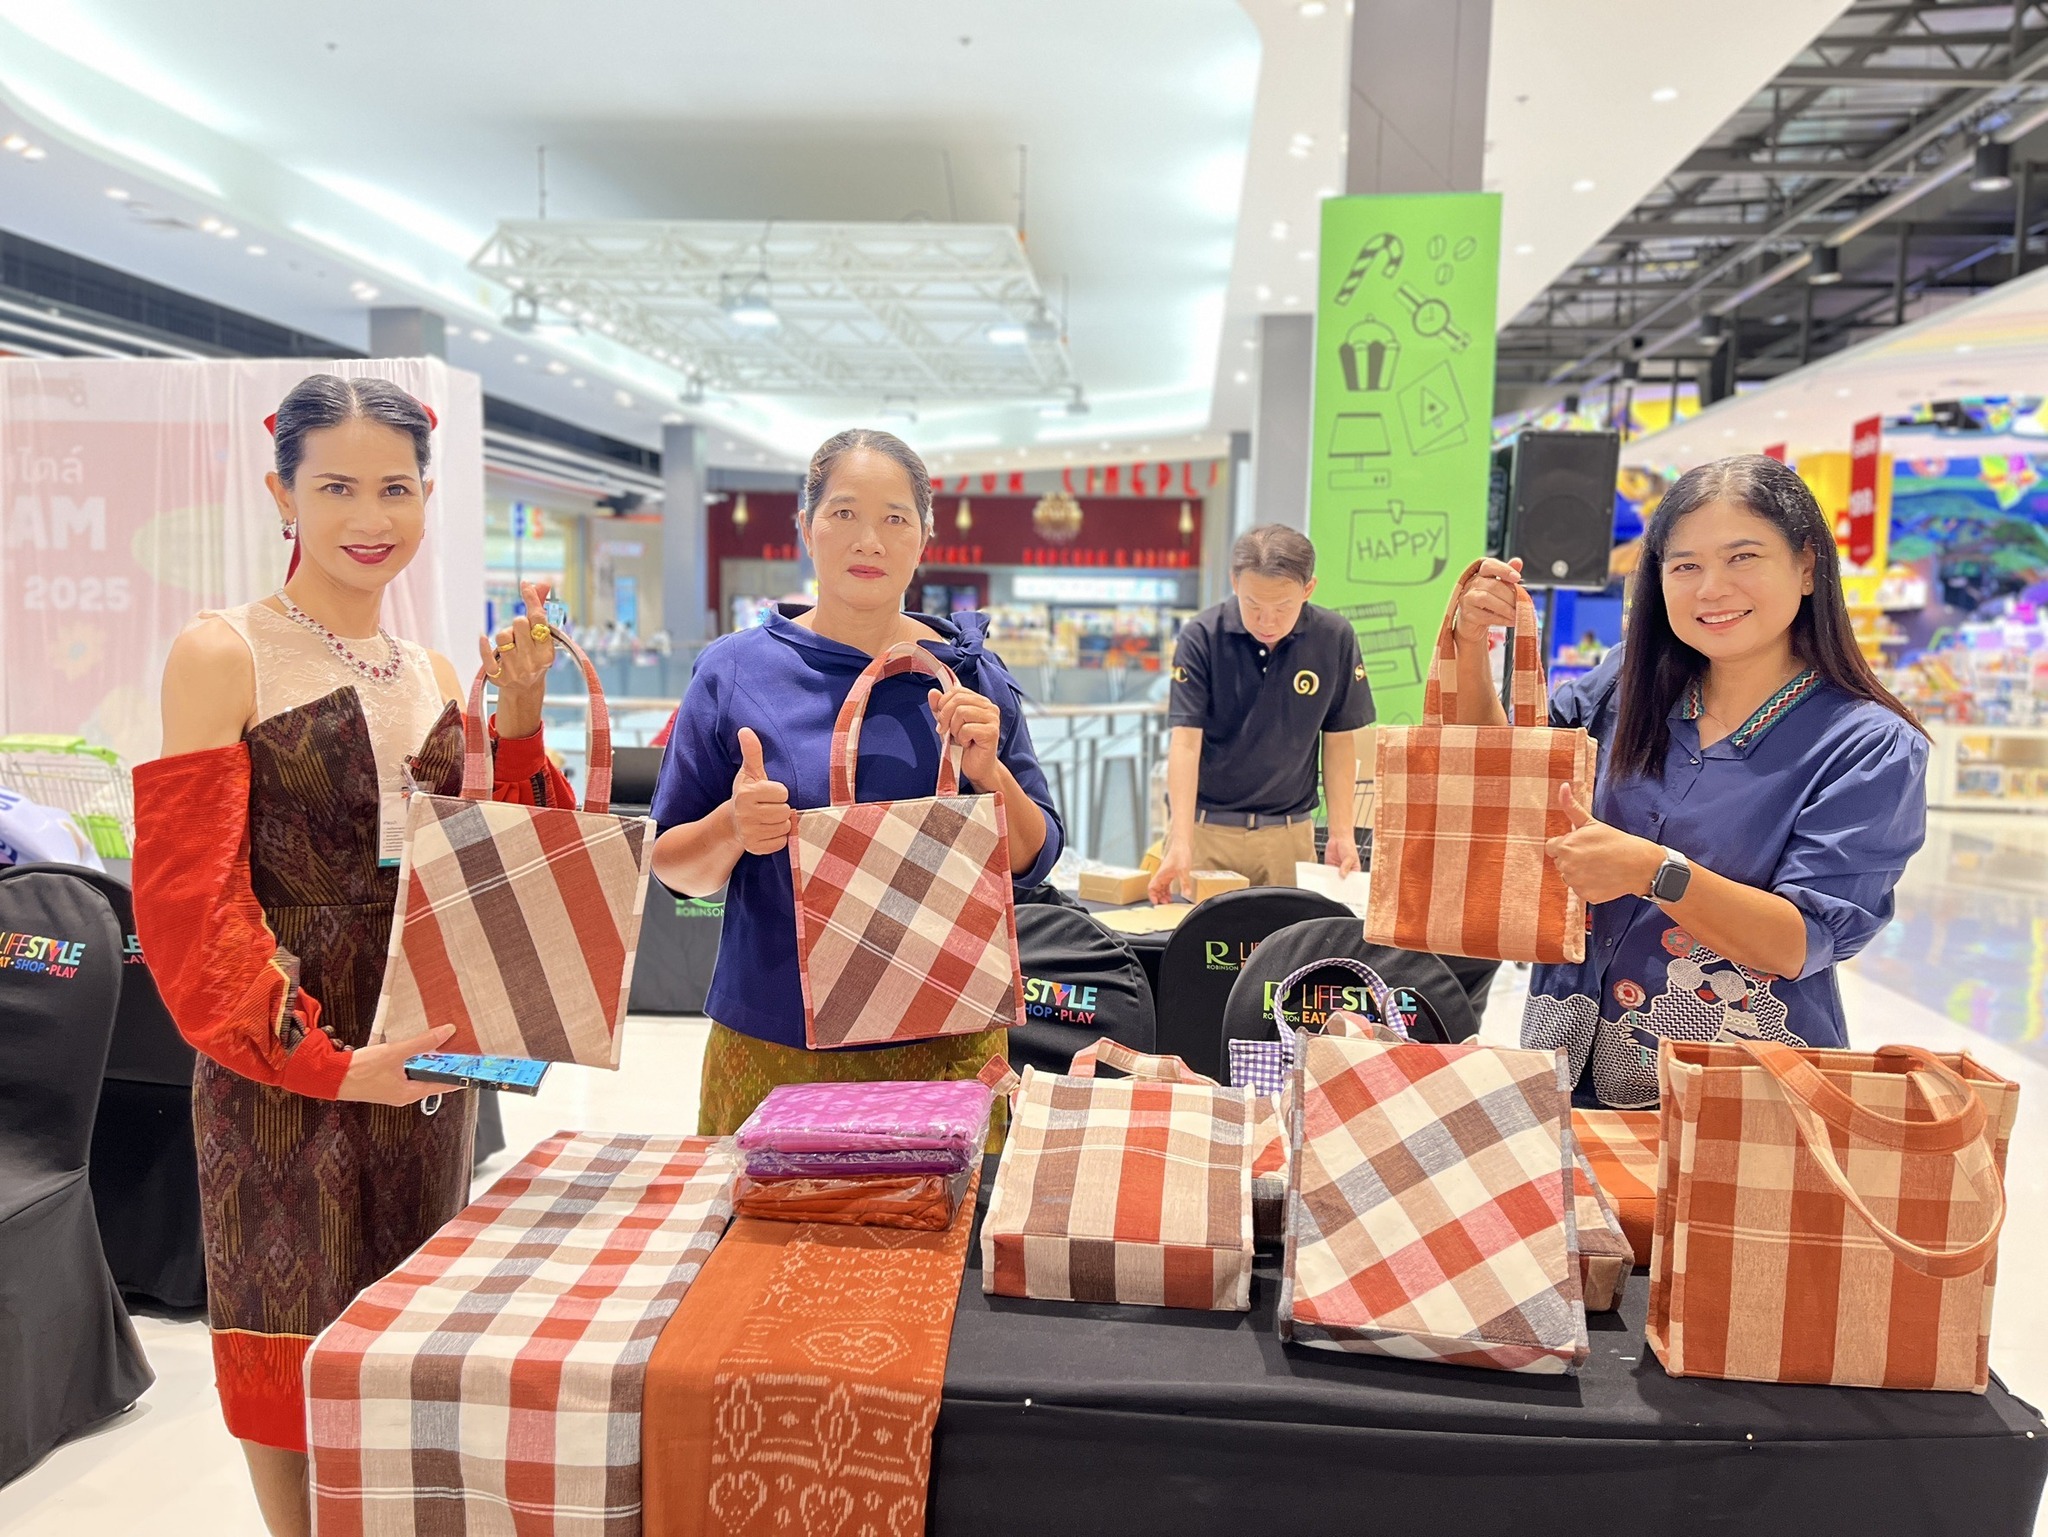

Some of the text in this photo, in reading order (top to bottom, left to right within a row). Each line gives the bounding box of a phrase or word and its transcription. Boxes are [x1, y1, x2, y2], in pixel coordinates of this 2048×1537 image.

[1356, 526, 1443, 562] HAPPY
[24, 575, 131, 613] 2025
[14, 958, 46, 973] SHOP
[49, 964, 78, 979] PLAY
[1060, 1009, 1096, 1025] PLAY
[1302, 1010, 1327, 1024] EAT
